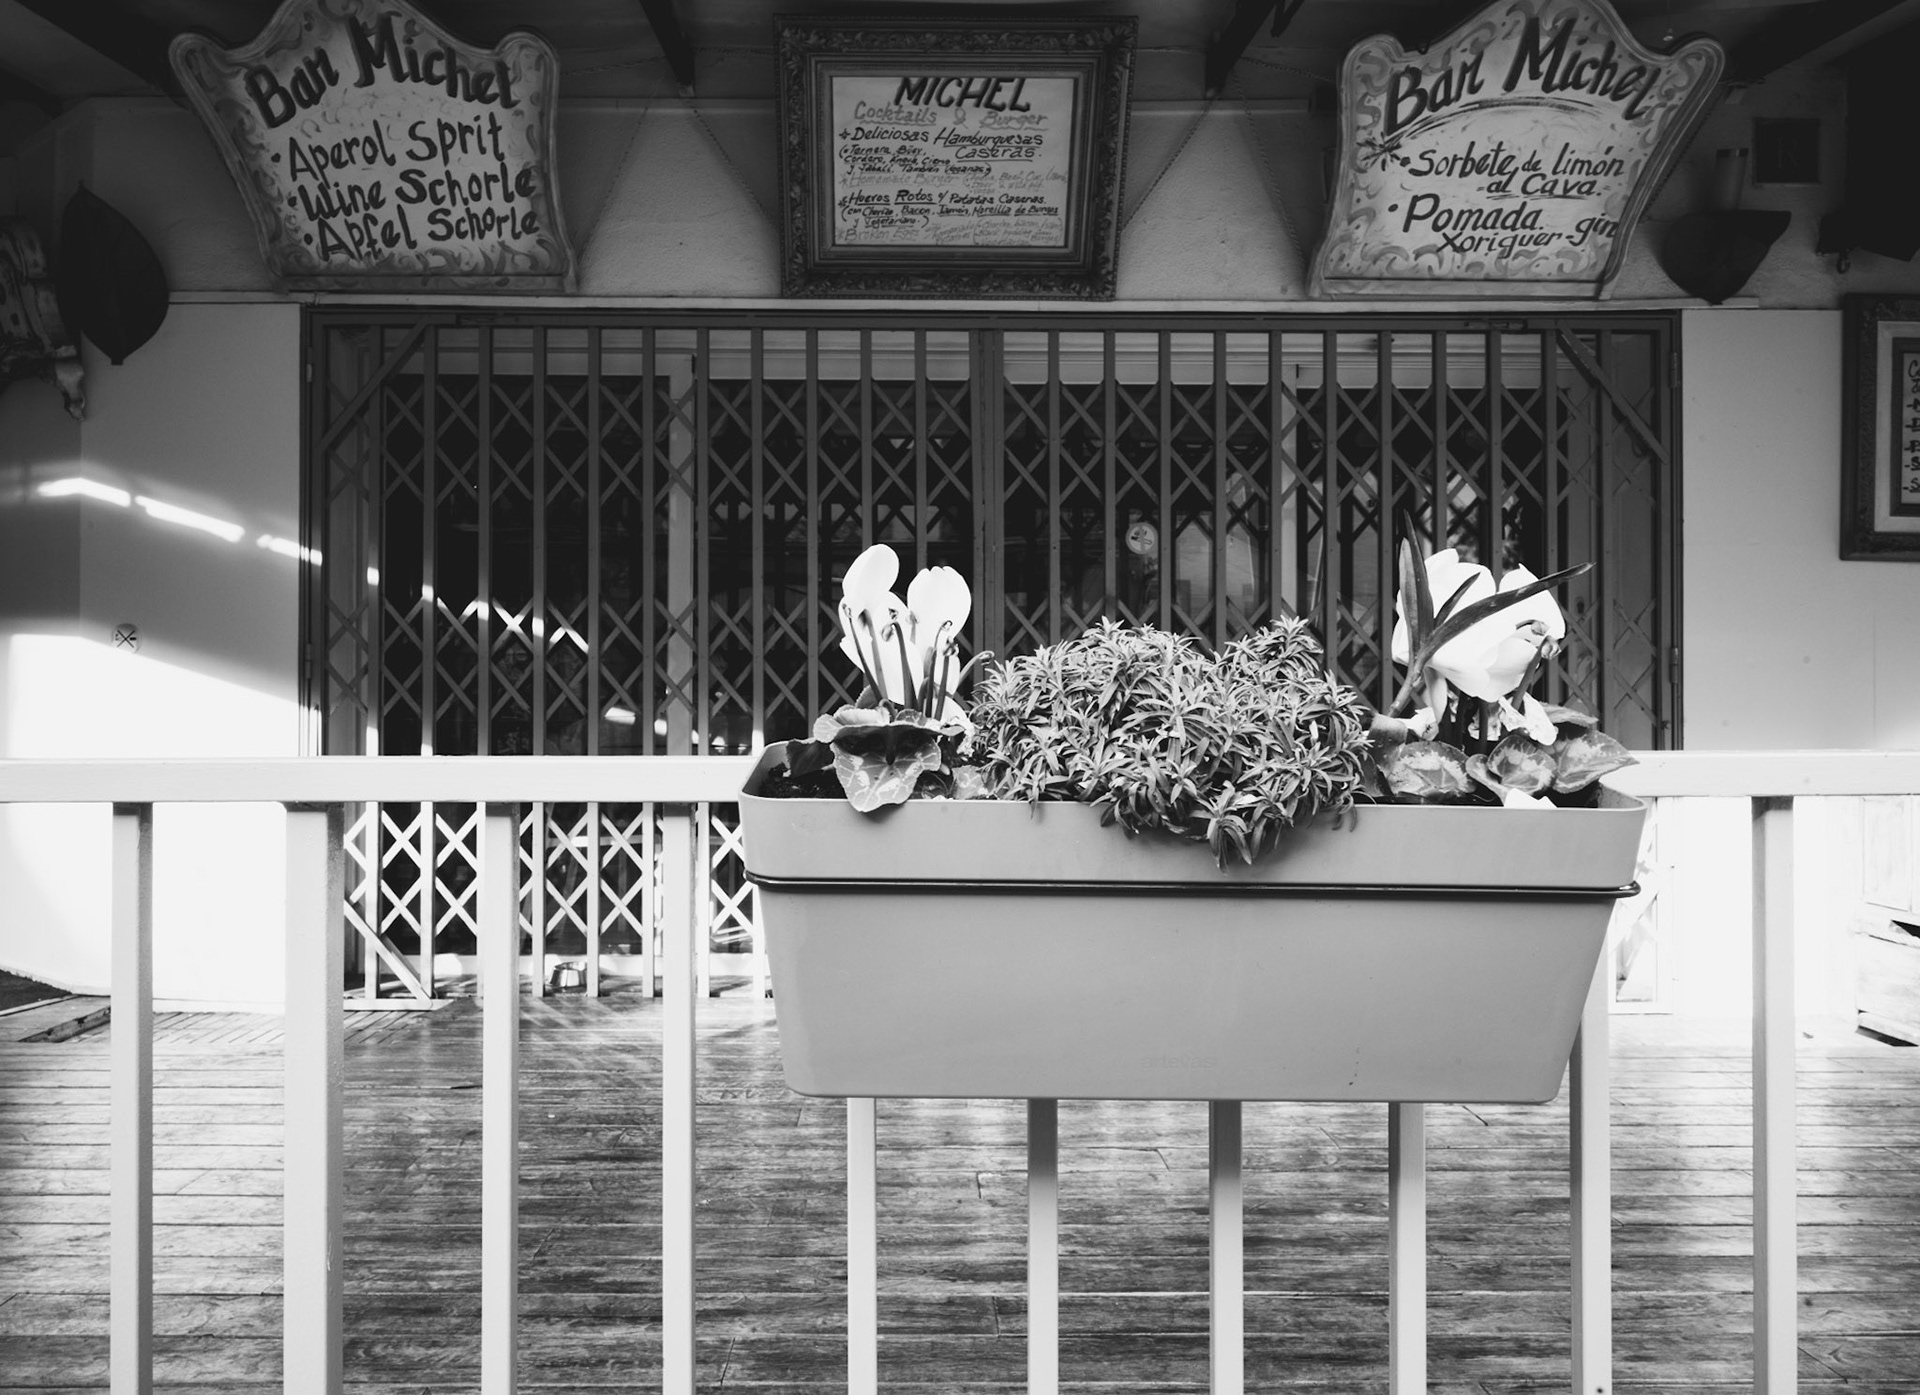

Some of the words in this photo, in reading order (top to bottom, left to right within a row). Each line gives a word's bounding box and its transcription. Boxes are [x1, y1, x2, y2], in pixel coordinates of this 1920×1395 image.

[244, 46, 339, 128] Bar
[346, 11, 520, 109] Michel
[1384, 50, 1485, 134] Bar
[1502, 16, 1661, 120] Michel
[894, 77, 1030, 112] MICHEL
[855, 101, 938, 124] Cocktails
[979, 111, 1048, 131] Burger
[289, 119, 396, 189] Aperol
[405, 112, 505, 168] Sprit
[851, 126, 930, 142] Deliciosas
[933, 127, 1043, 149] Hamburguesas
[955, 146, 1042, 159] Caseras.
[1408, 141, 1517, 178] Sorbete
[1521, 150, 1542, 173] de
[1551, 142, 1624, 177] limón
[298, 180, 386, 221] Wine
[395, 162, 536, 207] Schorle
[895, 188, 933, 202] Rotos
[949, 193, 995, 205] Patatas
[1486, 166, 1519, 193] al
[1521, 172, 1602, 196] Cava.
[1402, 193, 1544, 233] Pomada.
[317, 204, 417, 261] Apfel
[427, 206, 540, 241] Schorle
